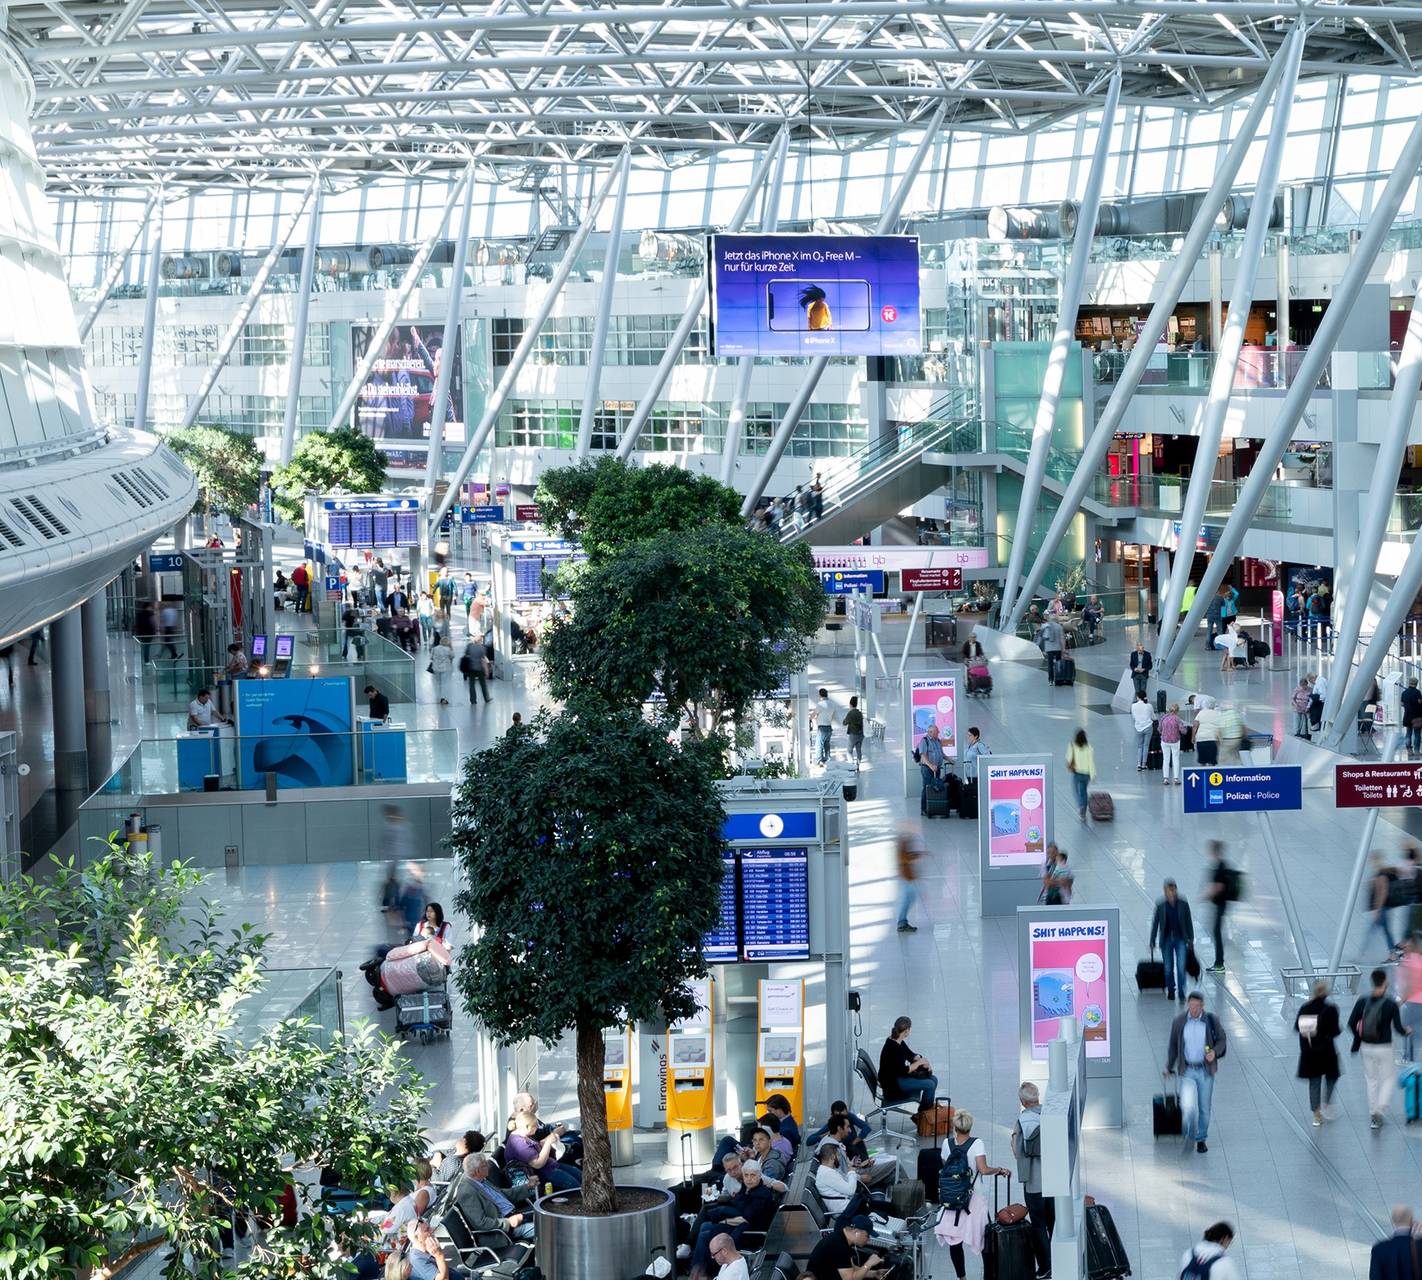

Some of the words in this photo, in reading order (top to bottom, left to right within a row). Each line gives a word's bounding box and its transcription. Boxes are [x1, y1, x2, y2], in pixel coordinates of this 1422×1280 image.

[724, 251, 744, 261] Jetzt
[745, 251, 760, 260] das
[761, 251, 791, 260] iPhone
[792, 251, 799, 260] X
[800, 251, 811, 260] im
[826, 251, 844, 260] Free
[845, 251, 854, 260] M
[724, 263, 739, 271] nur
[740, 262, 753, 271] für
[754, 262, 777, 271] kurze
[779, 262, 796, 271] Zeit.
[168, 557, 183, 566] 10
[329, 578, 336, 588] P
[1225, 773, 1271, 783] Information
[1342, 771, 1363, 779] Shops
[1372, 769, 1411, 778] Restaurants
[1354, 784, 1383, 792] Toiletten
[1226, 791, 1252, 801] Polizei
[1257, 790, 1280, 800] Police
[1363, 791, 1383, 799] Toilets
[1032, 928, 1057, 938] SHIT
[1058, 926, 1105, 937] HAPPENS!
[658, 1053, 667, 1112] Eurowings
